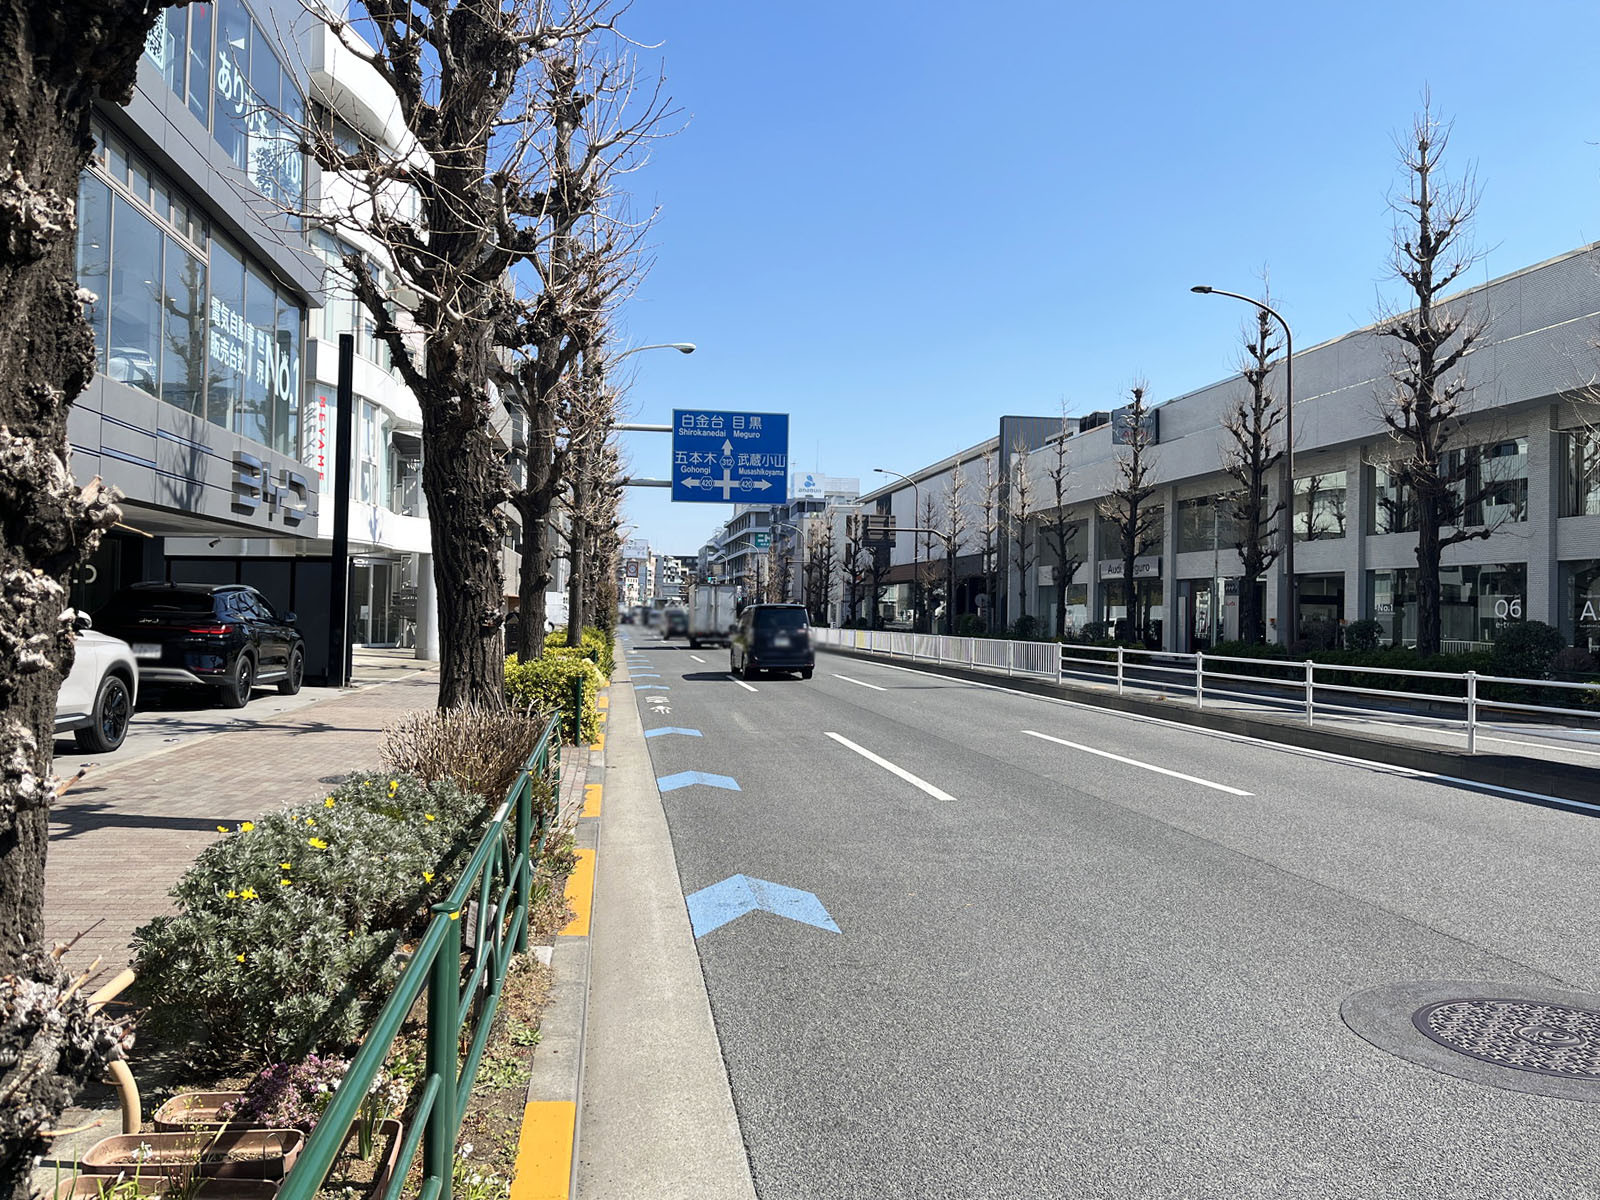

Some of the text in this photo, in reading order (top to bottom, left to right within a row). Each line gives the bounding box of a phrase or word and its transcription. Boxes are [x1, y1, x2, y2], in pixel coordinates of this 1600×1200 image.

[211, 296, 255, 346] 電気自動車
[210, 330, 246, 375] 販売台数
[257, 330, 299, 408] 世界 No.1
[682, 414, 762, 430] 白金台 目黒
[679, 428, 760, 439] Shirokanedai Meguro
[675, 451, 717, 465] 五本木
[722, 458, 732, 466] 312
[738, 453, 785, 467] 武蔵小山
[681, 466, 711, 475] Gohongi
[739, 467, 784, 477] Musashikoyama
[231, 451, 308, 520] BYD
[1107, 564, 1122, 574] Audi
[1495, 599, 1521, 620] Q6
[1580, 600, 1600, 621] A
[1495, 621, 1520, 629] e-tr
